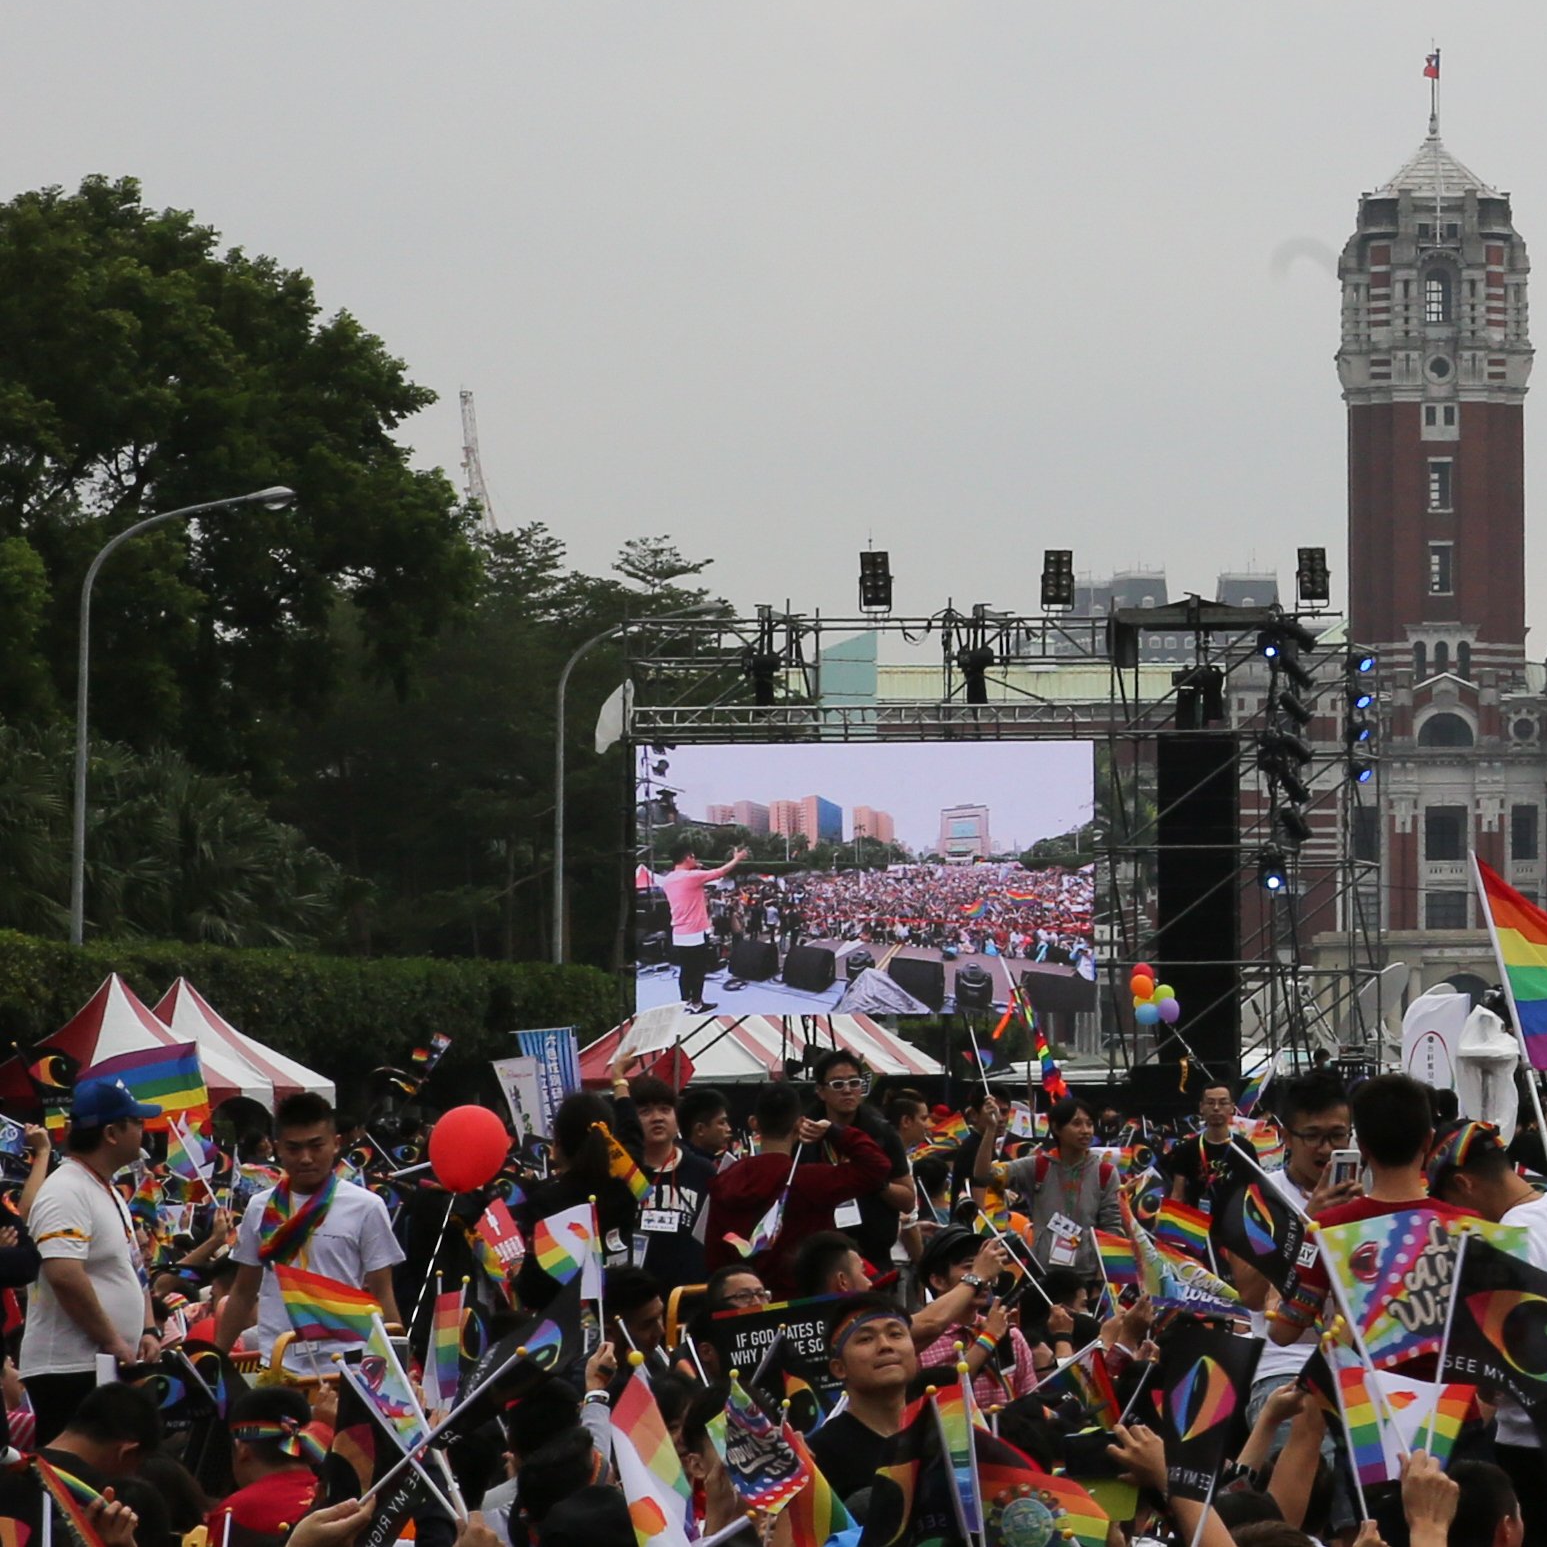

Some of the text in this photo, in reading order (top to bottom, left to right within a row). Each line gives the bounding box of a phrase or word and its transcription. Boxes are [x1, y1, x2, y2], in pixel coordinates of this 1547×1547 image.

[735, 1332, 749, 1350] IF
[751, 1328, 777, 1346] GOD
[780, 1322, 815, 1341] ATES
[730, 1347, 758, 1367] WHY
[1442, 1354, 1478, 1374] SEE
[1483, 1363, 1505, 1383] MY
